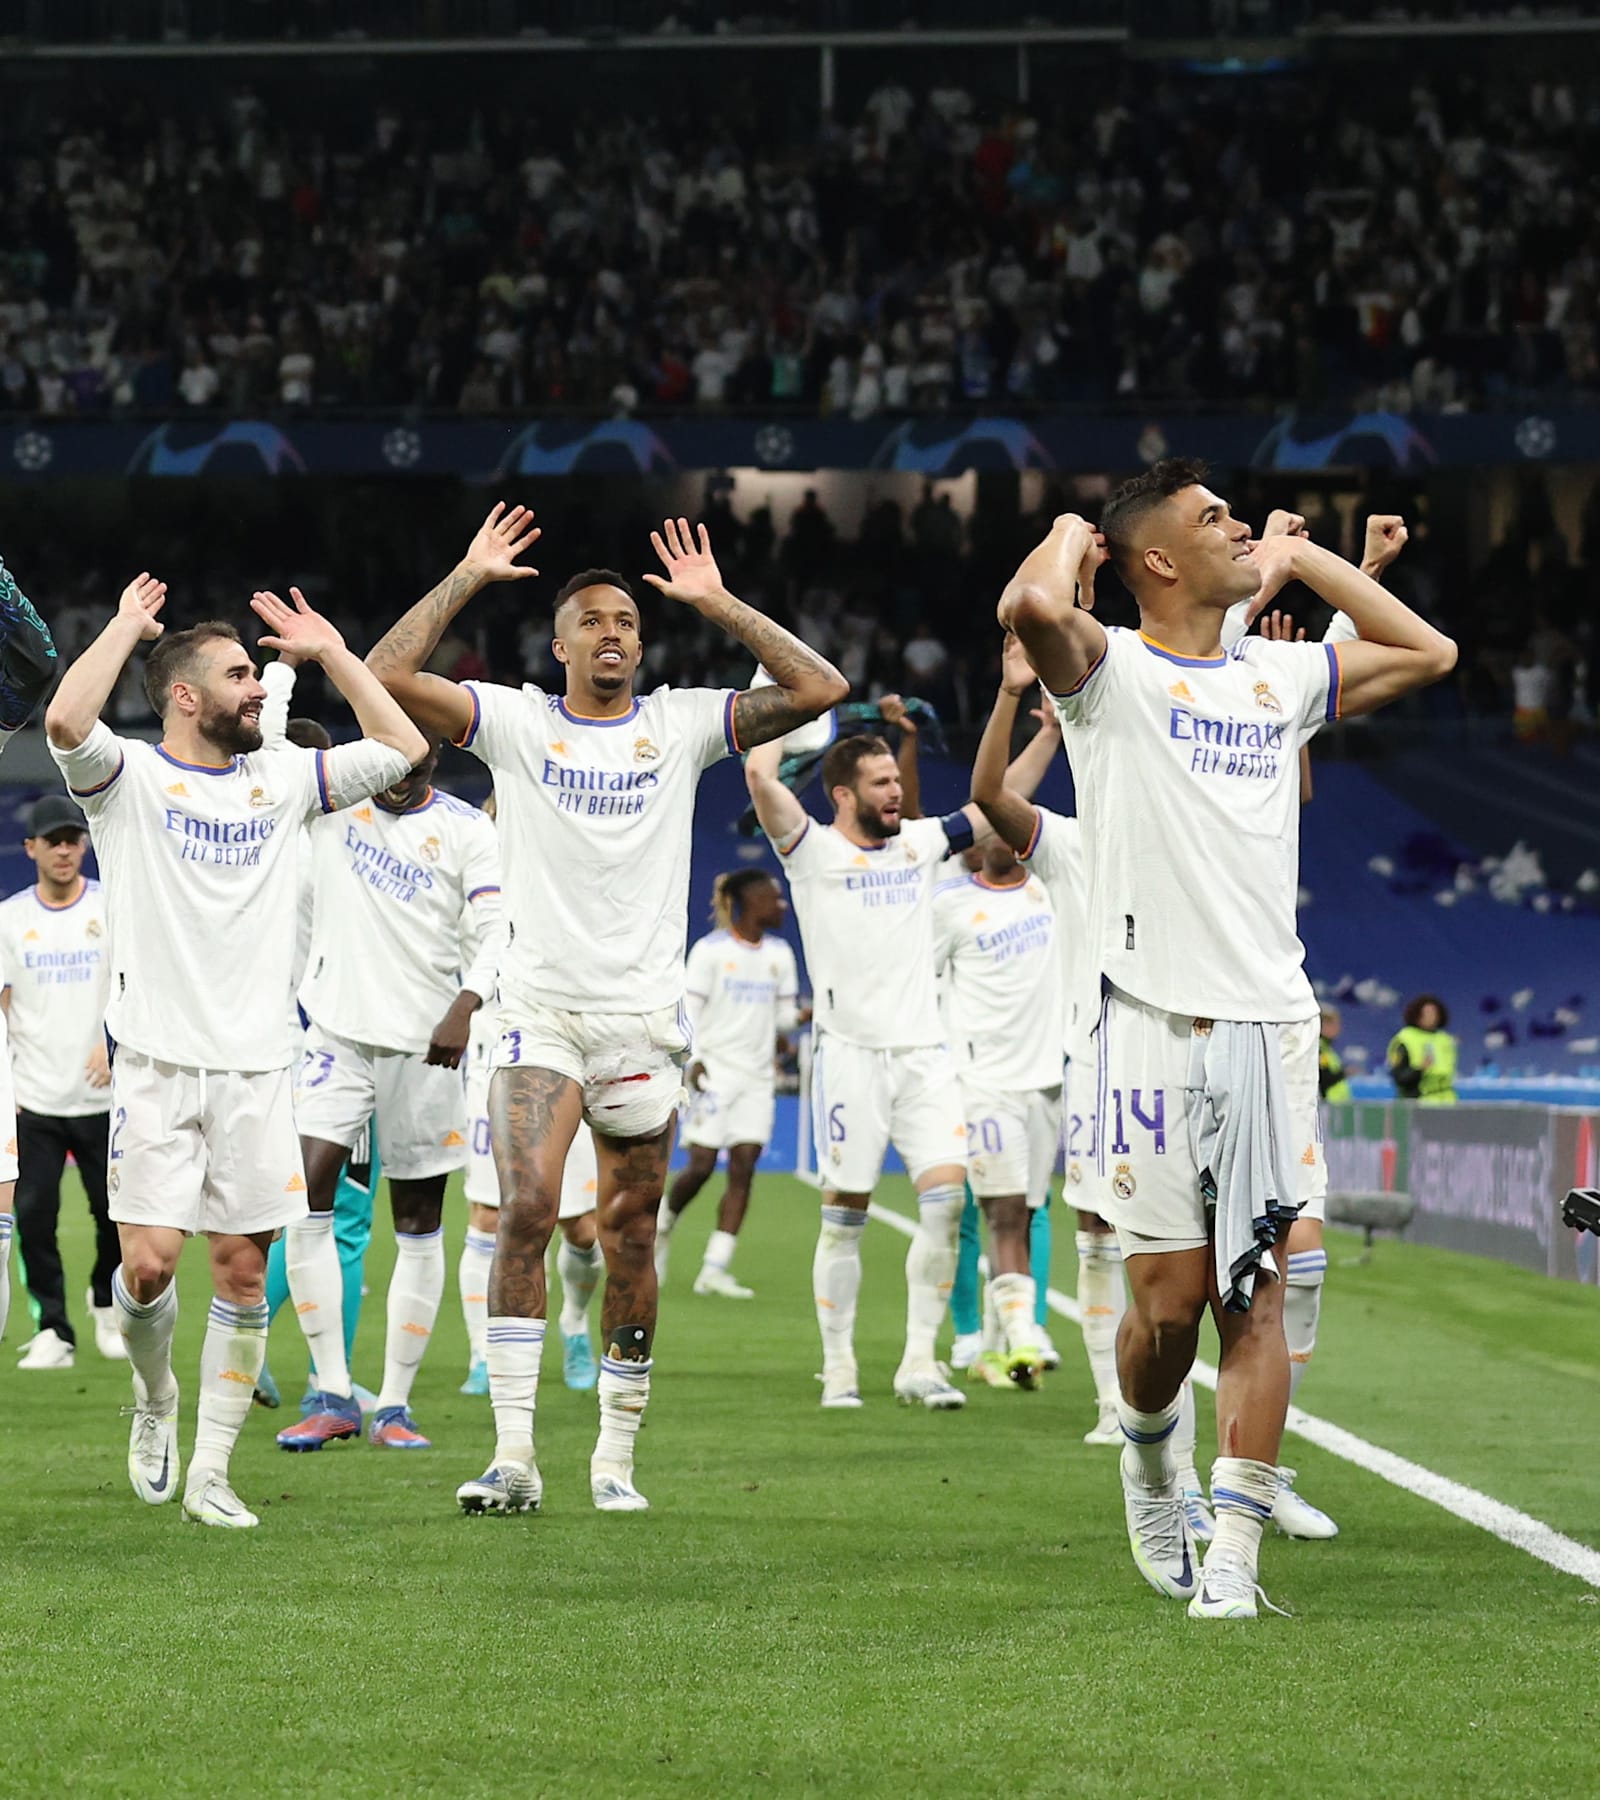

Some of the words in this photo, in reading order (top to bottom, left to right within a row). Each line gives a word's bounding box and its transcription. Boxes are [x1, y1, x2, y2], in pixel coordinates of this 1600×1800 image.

[1170, 708, 1284, 750] Emirates
[542, 758, 659, 791] Emirates
[1191, 748, 1220, 774] FLY
[1225, 752, 1279, 780] BETTER
[557, 792, 582, 814] FLY
[587, 794, 644, 815] BETTER
[165, 808, 276, 844] Emirates
[181, 839, 207, 862] FLY
[215, 844, 263, 866] BETTER
[344, 823, 434, 890] Emirates
[368, 868, 417, 904] BETTER
[846, 868, 922, 891] Emirates
[976, 912, 1053, 951] Emirates
[1112, 1088, 1166, 1155] 14
